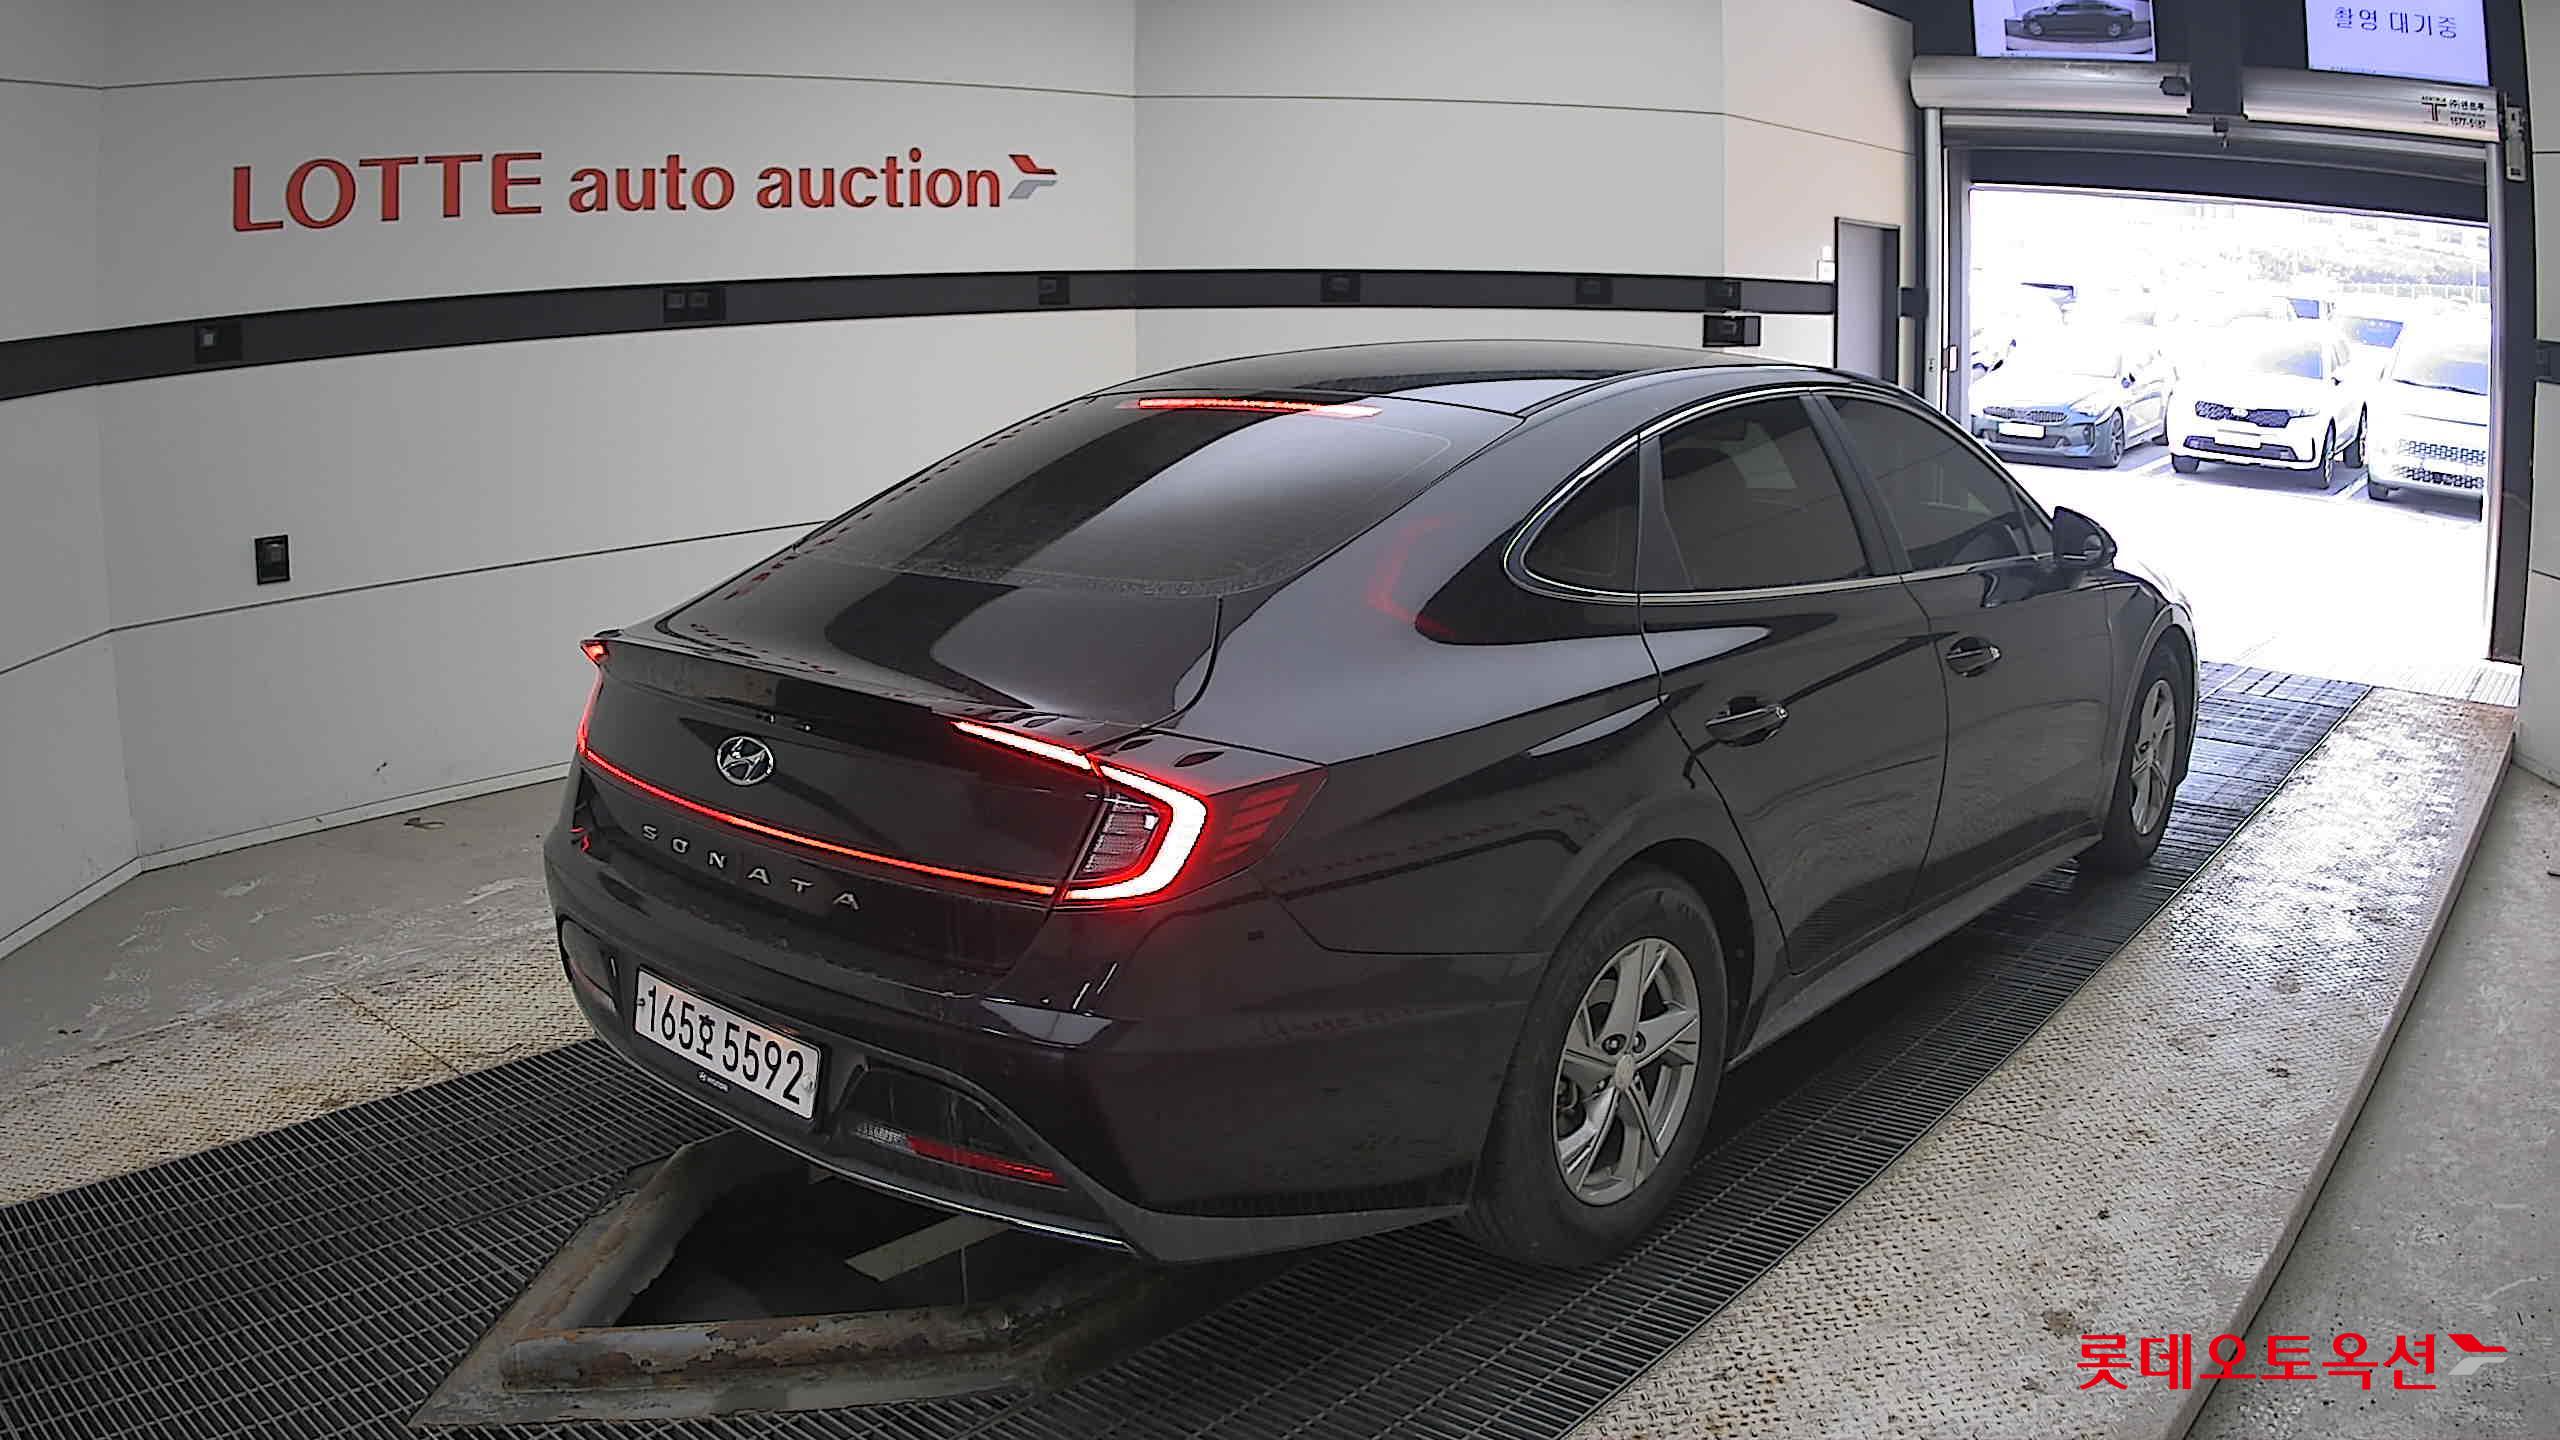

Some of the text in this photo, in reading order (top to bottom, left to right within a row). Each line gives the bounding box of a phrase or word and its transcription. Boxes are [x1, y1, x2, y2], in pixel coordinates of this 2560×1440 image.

[2334, 6, 2458, 40] 촬영 대기중
[233, 148, 1003, 232] LOTTE auto auction
[641, 824, 860, 911] SONATA
[648, 984, 804, 1105] 165호 5592
